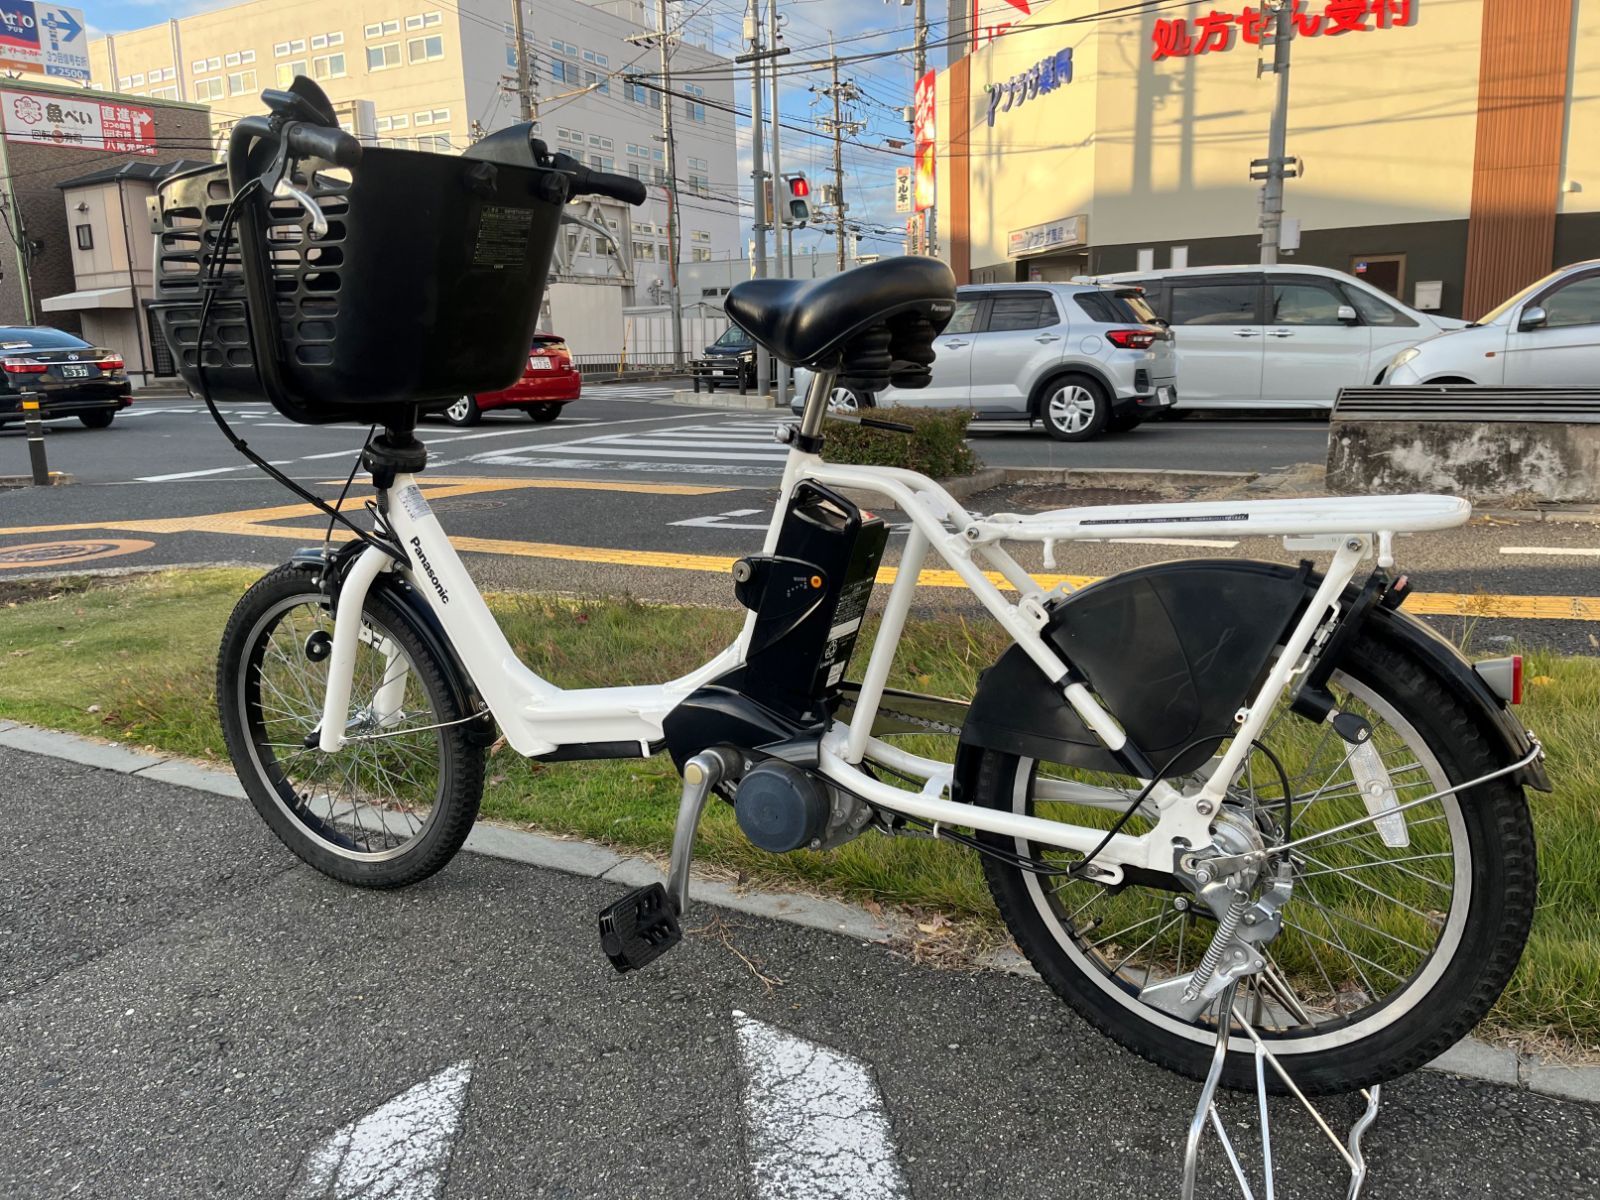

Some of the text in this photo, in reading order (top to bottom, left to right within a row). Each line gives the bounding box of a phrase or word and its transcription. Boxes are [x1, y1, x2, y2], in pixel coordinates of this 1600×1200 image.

[46, 102, 93, 125] 魚べい
[101, 105, 131, 123] 直進
[897, 175, 909, 203] マルキ
[410, 535, 449, 605] Panasonic
